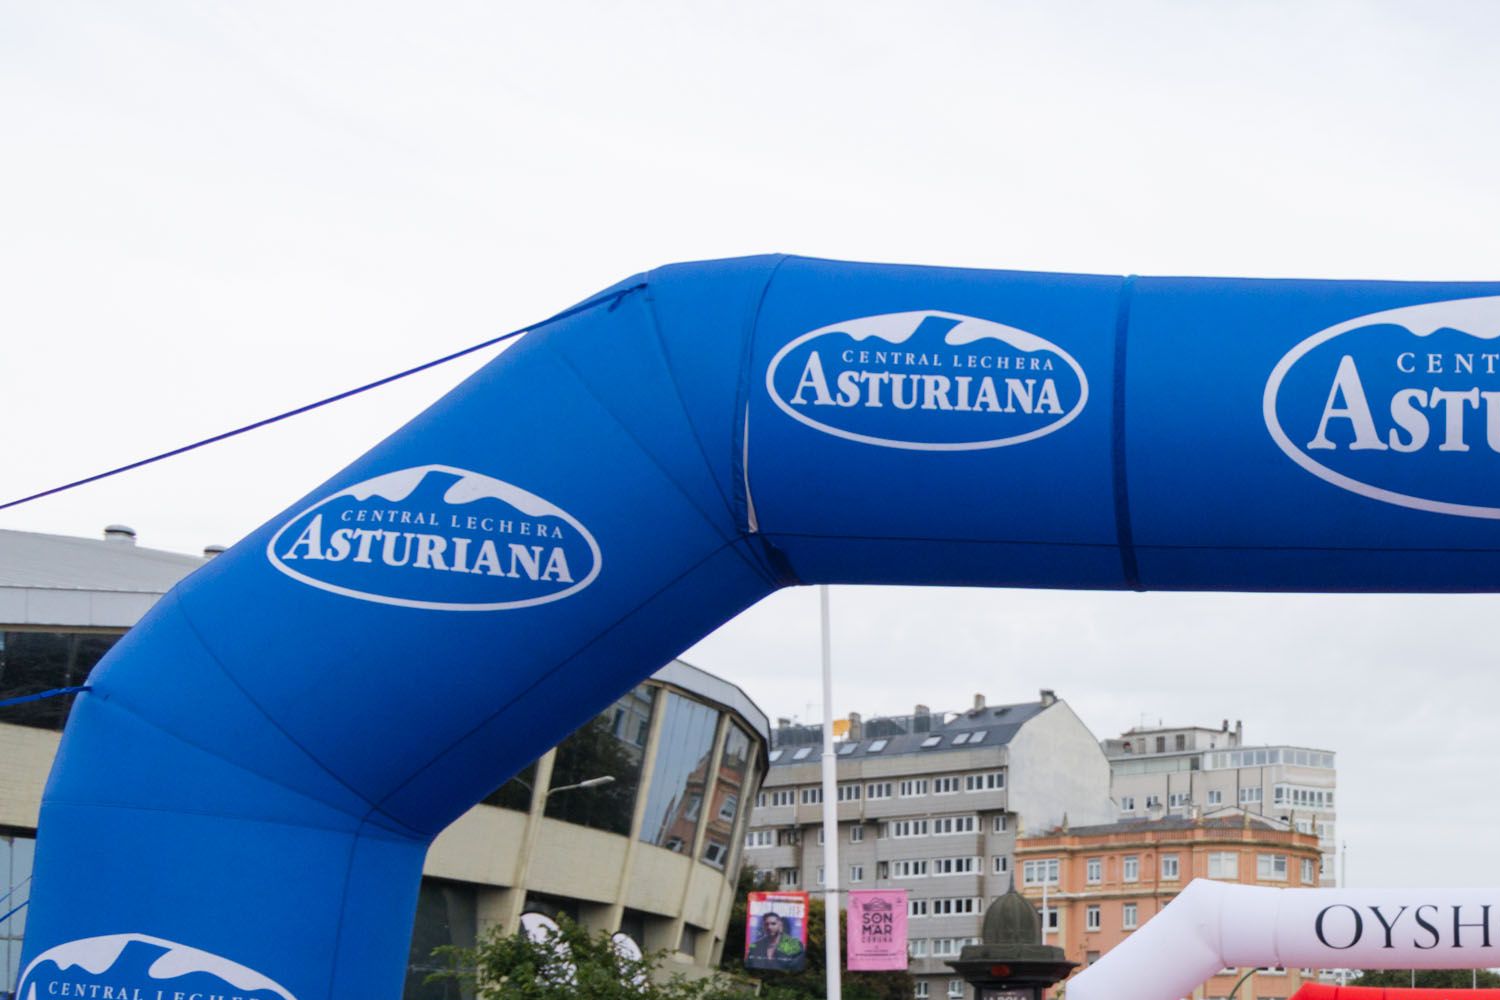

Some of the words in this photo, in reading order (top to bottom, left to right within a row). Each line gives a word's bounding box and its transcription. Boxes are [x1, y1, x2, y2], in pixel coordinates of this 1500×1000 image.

[842, 349, 942, 367] CENTRAL
[953, 354, 1054, 372] LECHERA
[790, 350, 1064, 415] ASTURIANA
[340, 509, 442, 527] CENTRAL
[450, 514, 565, 540] LECHERA
[283, 513, 575, 584] ASTURIANA
[862, 913, 893, 924] SON
